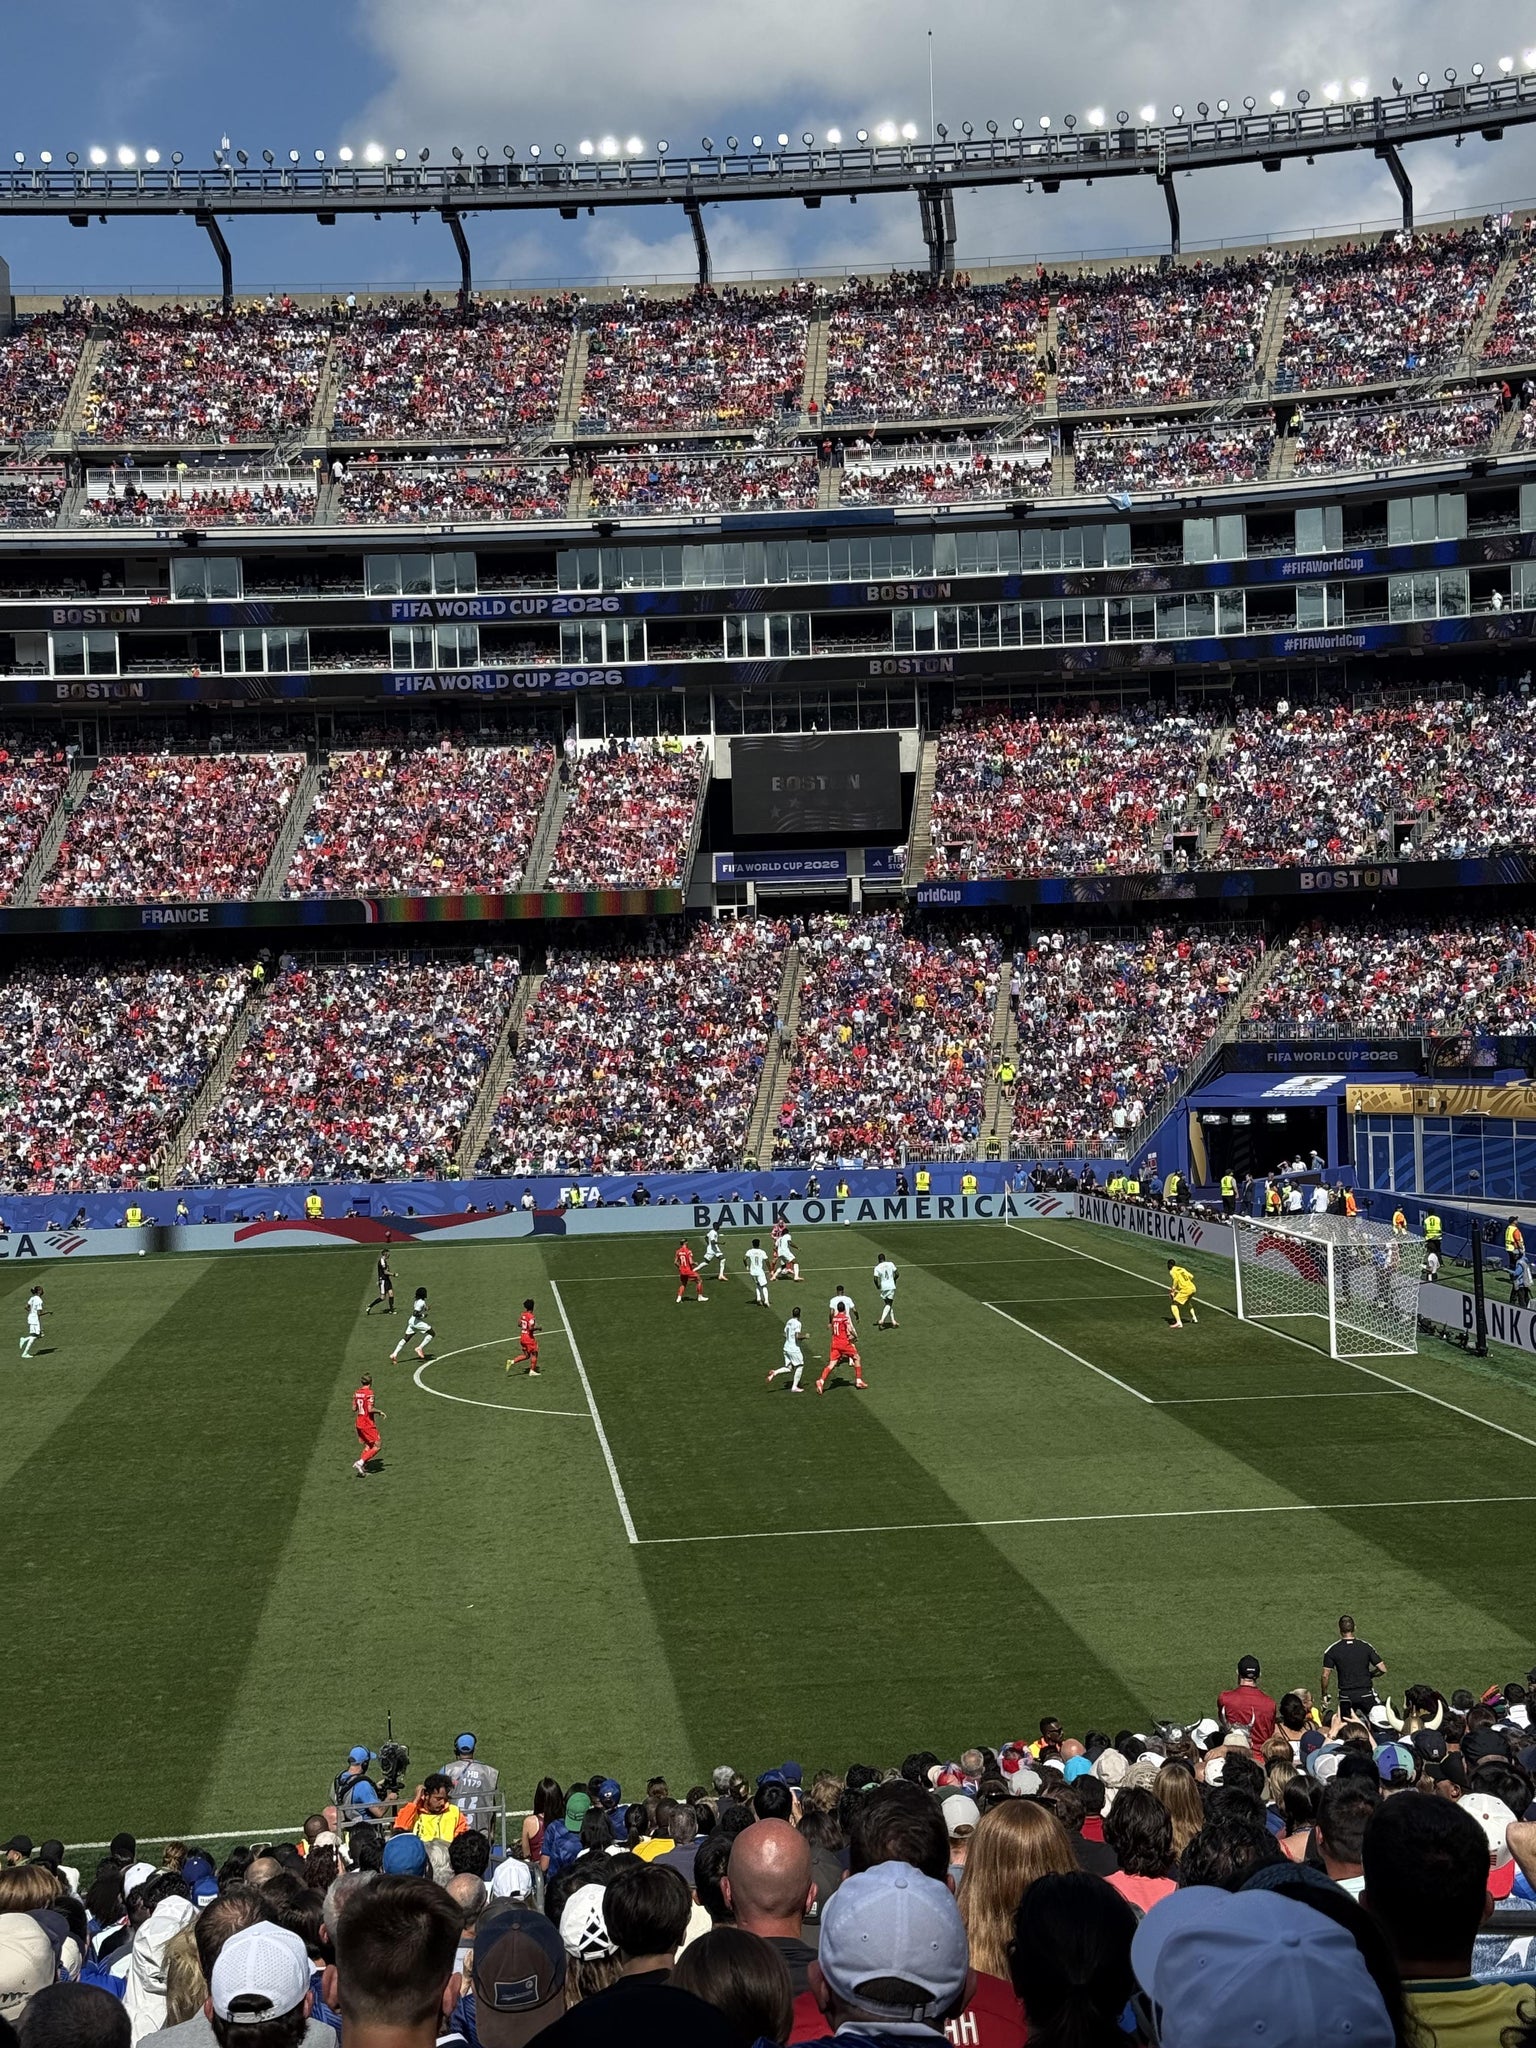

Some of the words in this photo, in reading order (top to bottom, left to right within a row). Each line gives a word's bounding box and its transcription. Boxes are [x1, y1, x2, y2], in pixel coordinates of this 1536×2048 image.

[1282, 557, 1364, 575] #FIFAWorldCup
[866, 583, 951, 601] BOSTON
[391, 602, 433, 618] FIFA
[435, 600, 506, 617] WORLD
[509, 598, 548, 615] CUP
[551, 596, 621, 613] 2026
[53, 608, 140, 624] BOSTON
[1284, 634, 1366, 651] #FIFAWorldCup
[869, 657, 954, 675] BOSTON
[395, 676, 436, 691] FIFA
[438, 674, 509, 690] WORLD
[512, 672, 551, 688] CUP
[555, 670, 623, 687] 2026
[56, 683, 144, 698] BOSTON
[722, 864, 744, 873] FIFA
[745, 862, 781, 872] WORLD
[782, 861, 803, 870] CUP
[804, 860, 840, 870] 2026
[1300, 868, 1398, 890] BOSTON
[917, 889, 961, 904] orldCup
[142, 908, 209, 924] FRANCE
[1267, 1052, 1292, 1062] FIFA
[1293, 1051, 1336, 1061] WORLD
[1337, 1051, 1359, 1060] CUP
[1360, 1051, 1399, 1060] 2026
[560, 1186, 601, 1203] FFA
[693, 1202, 791, 1228] BANK
[802, 1200, 846, 1223] OF
[857, 1195, 1019, 1221] AMERICA
[1079, 1195, 1109, 1224] BANK
[1112, 1203, 1126, 1228] OF
[1129, 1208, 1186, 1244] AMERICA
[1462, 1294, 1523, 1346] BNK
[462, 1778, 482, 1788] 1179
[467, 1771, 479, 1779] HB
